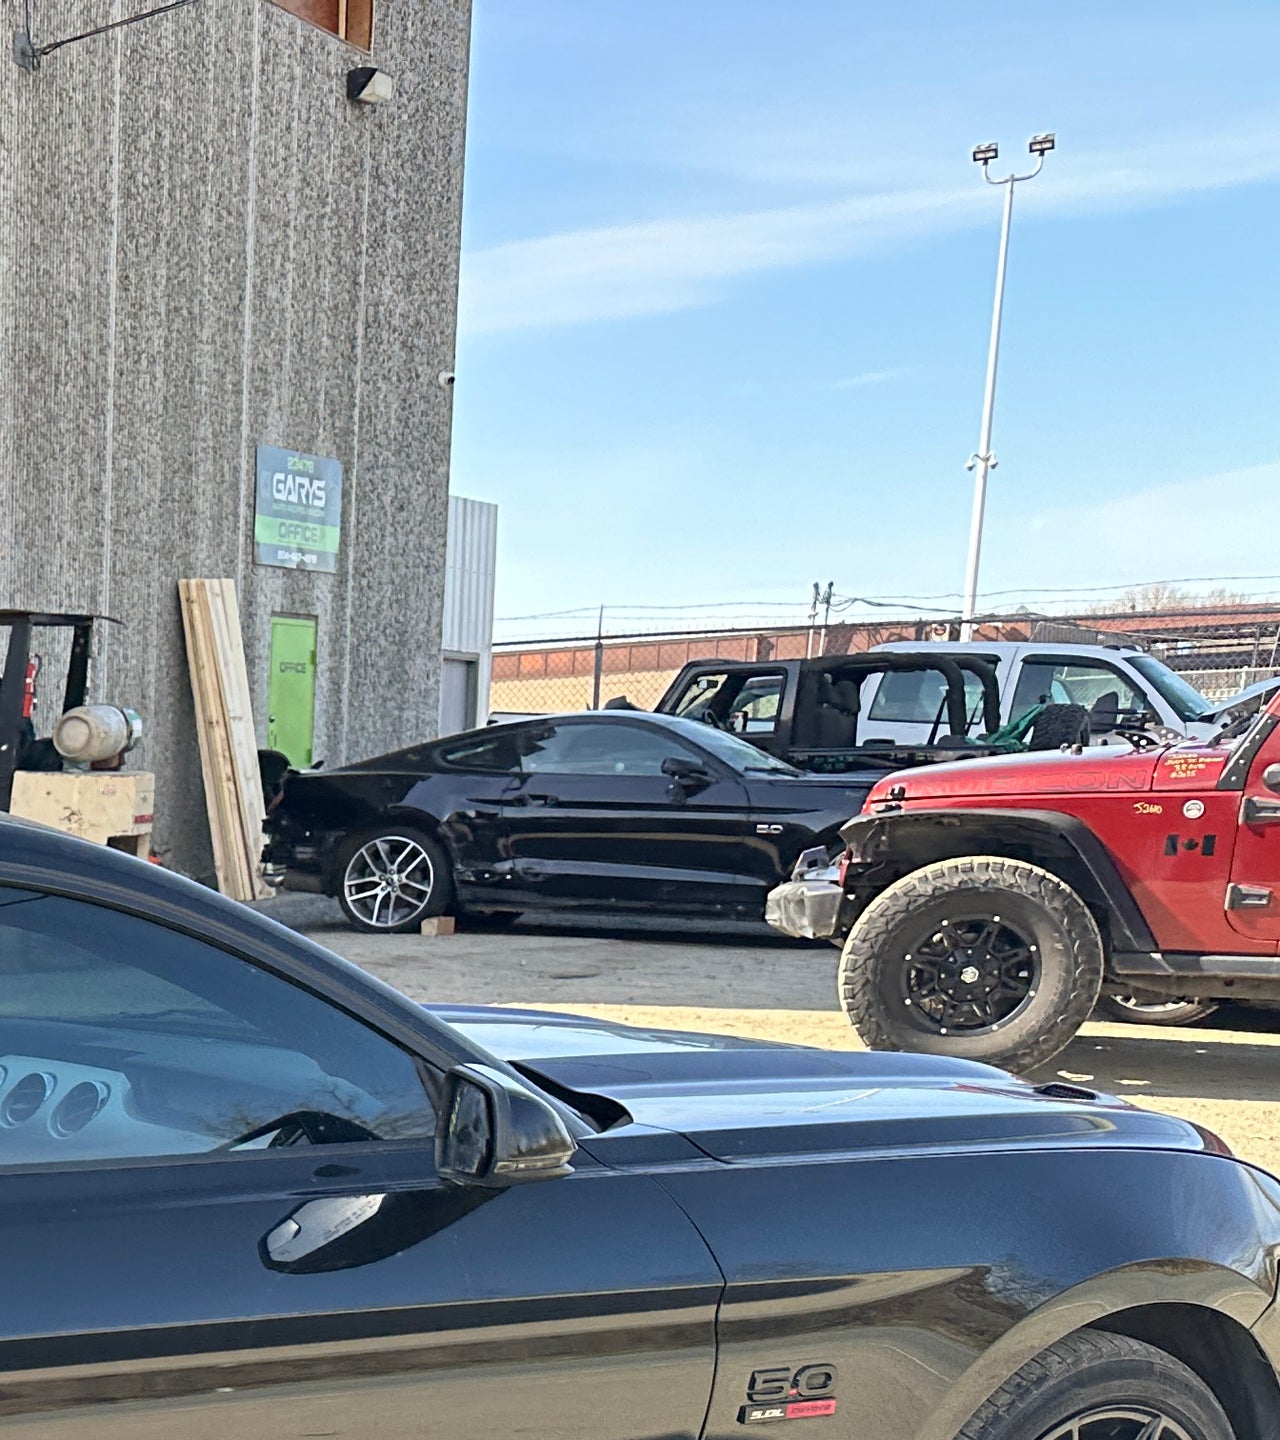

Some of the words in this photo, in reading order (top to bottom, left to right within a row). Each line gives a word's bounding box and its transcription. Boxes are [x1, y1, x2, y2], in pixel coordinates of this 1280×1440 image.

[272, 472, 326, 507] GARYS
[278, 521, 319, 543] OFFICE
[746, 1362, 838, 1402] 5.0
